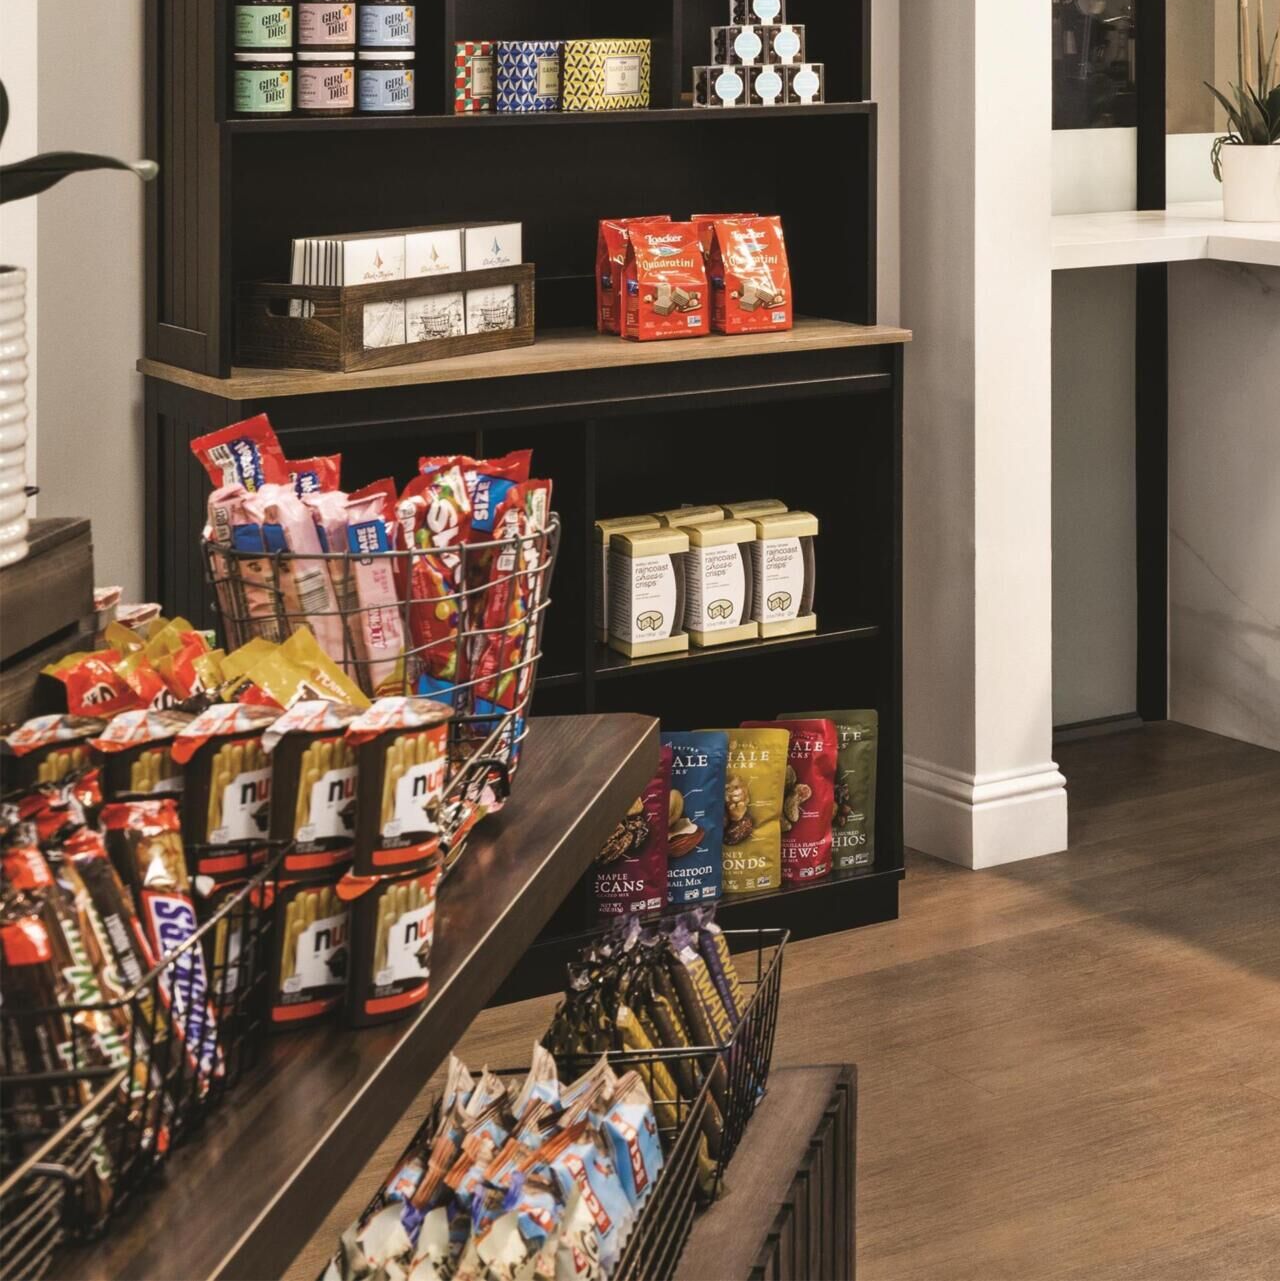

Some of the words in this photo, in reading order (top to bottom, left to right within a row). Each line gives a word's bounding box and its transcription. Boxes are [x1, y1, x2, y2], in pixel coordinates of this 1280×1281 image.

[642, 258, 694, 271] Quadratini
[473, 481, 490, 521] SIZE
[367, 526, 379, 551] SIZE
[356, 527, 372, 566] SARE
[766, 546, 798, 556] raincoast
[705, 554, 737, 563] raincoast
[635, 564, 669, 575] raincoast
[766, 561, 786, 570] crisps
[705, 569, 726, 577] crisps
[635, 580, 657, 589] crisps
[597, 873, 628, 881] MAPLE
[713, 934, 748, 1017] AWAKE
[687, 958, 733, 1042] AWAKE
